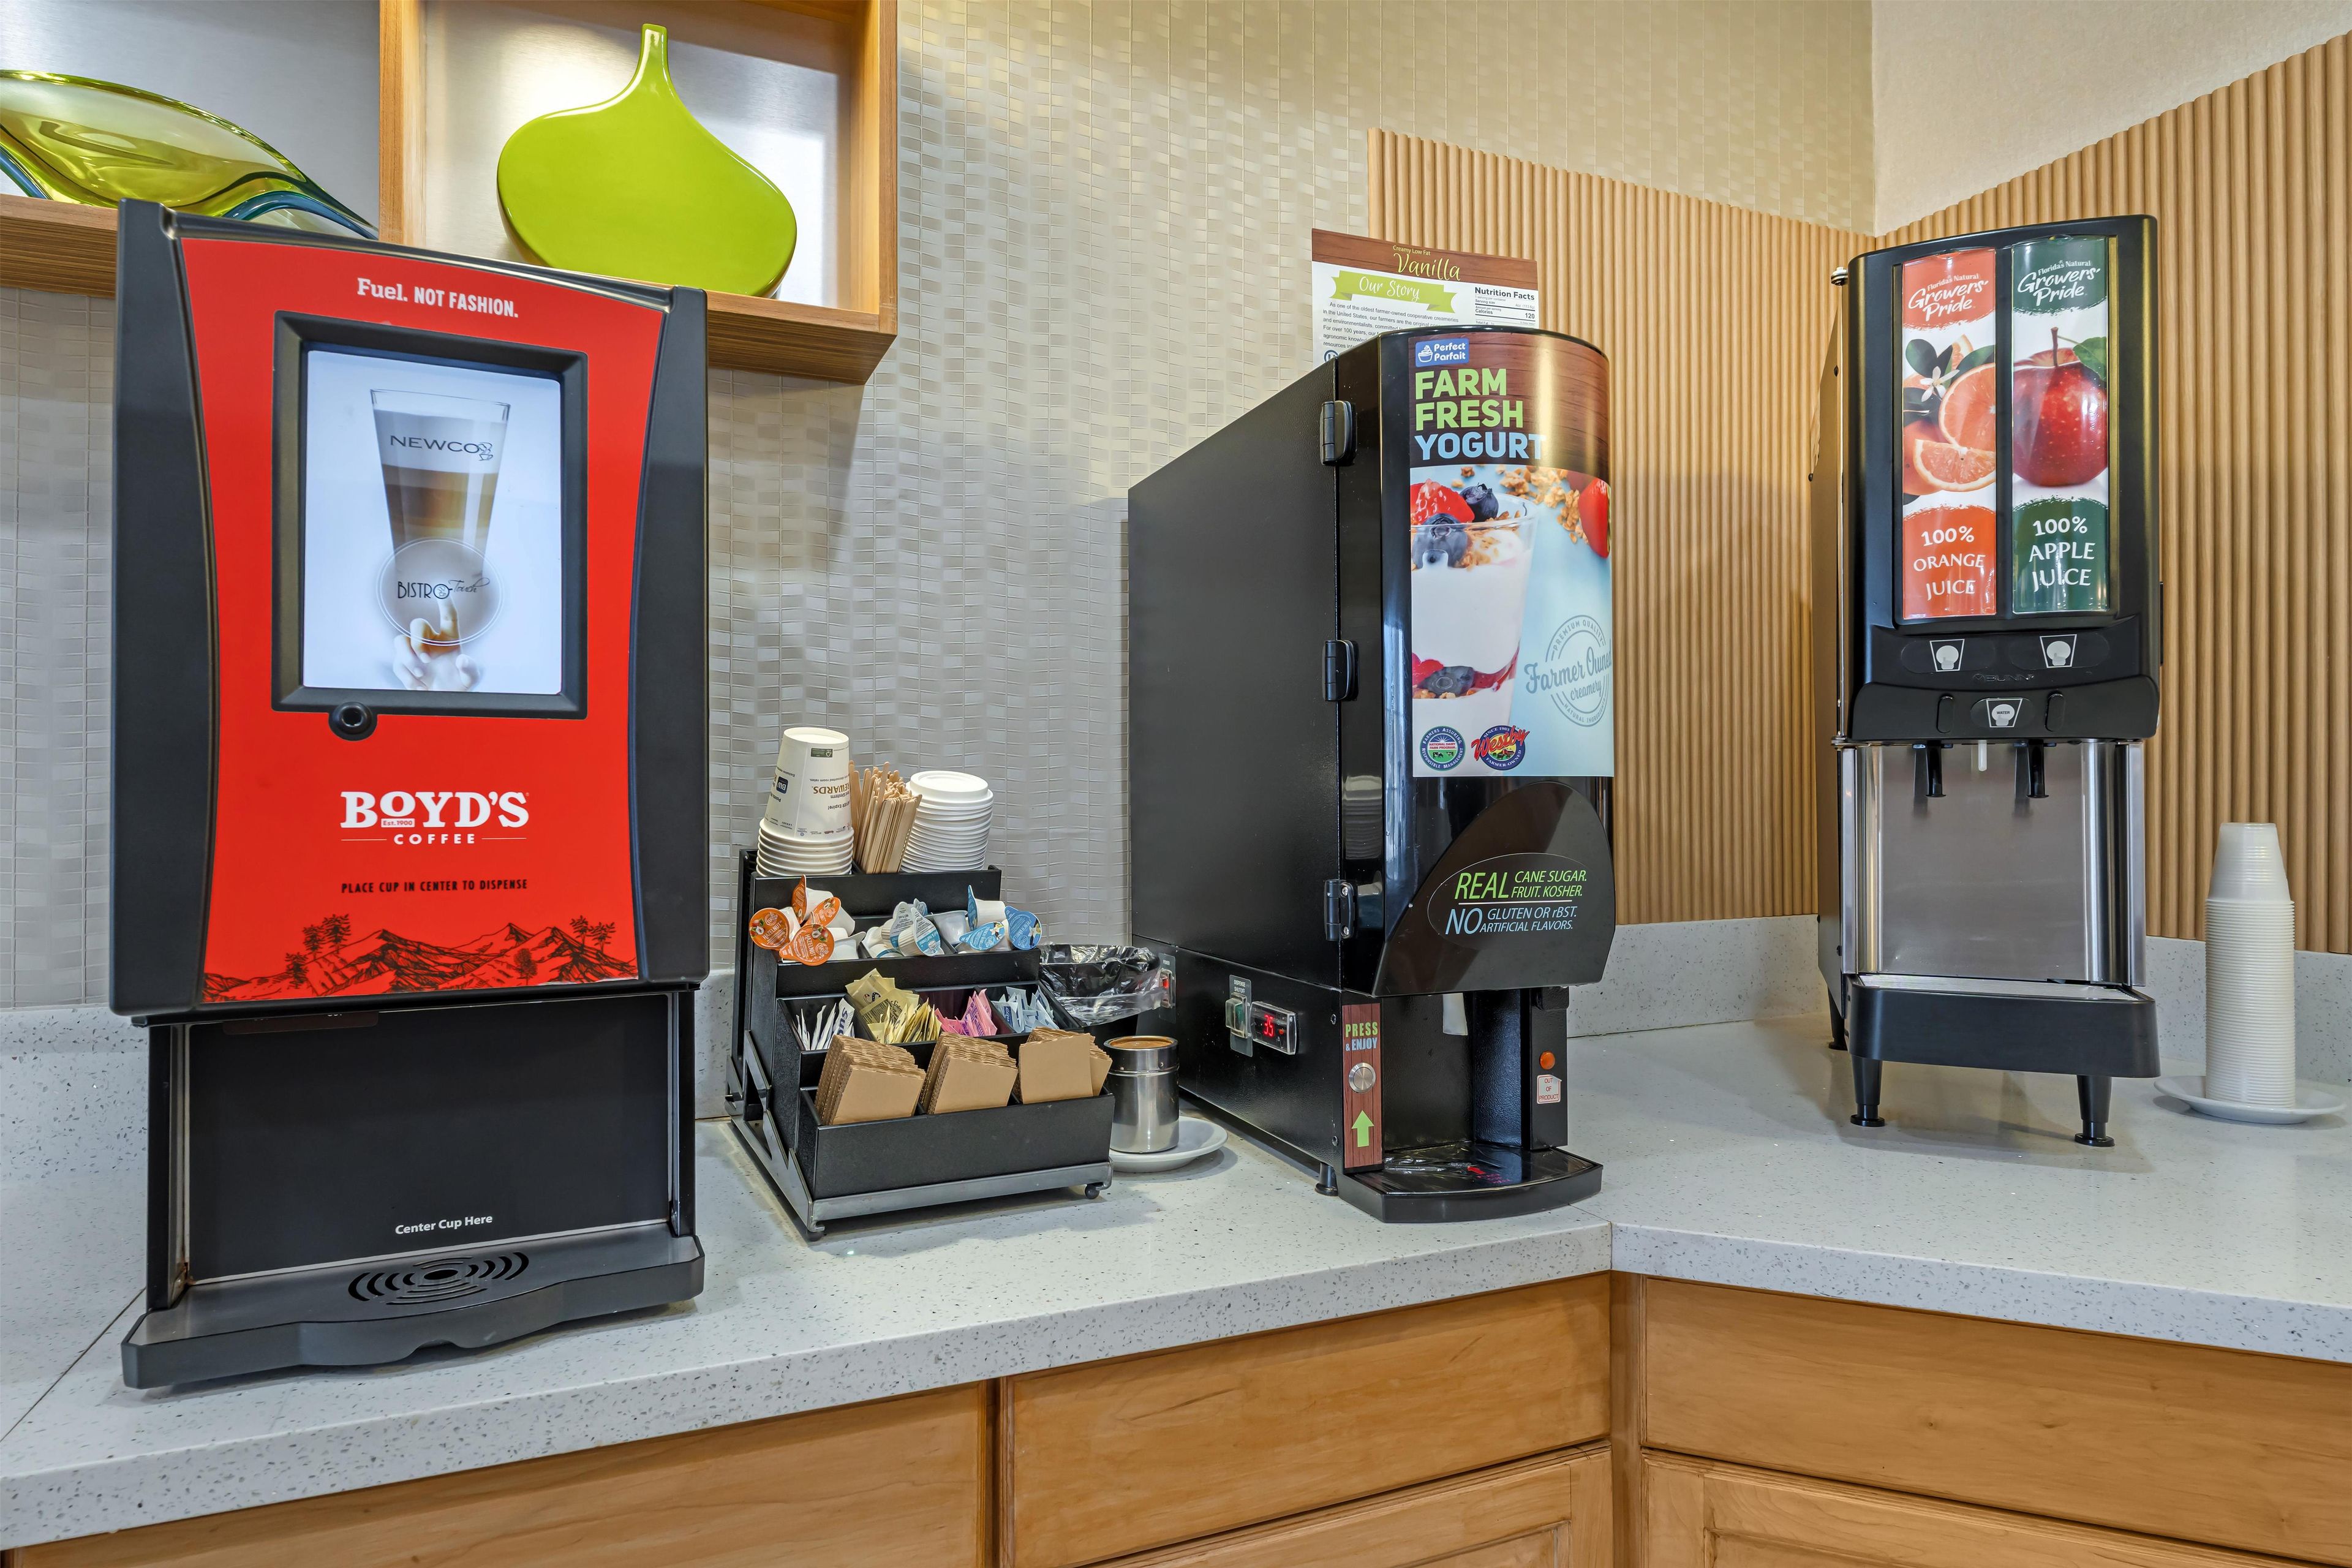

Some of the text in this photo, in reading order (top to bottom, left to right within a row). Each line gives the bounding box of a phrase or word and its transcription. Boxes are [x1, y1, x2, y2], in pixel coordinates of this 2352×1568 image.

[1393, 245, 1411, 254] Creamy
[1393, 252, 1461, 281] Vanilla
[1359, 276, 1420, 302] Our Story
[2018, 268, 2101, 293] Growers'
[357, 277, 518, 318] Fuel. NOT FASHION.
[1475, 287, 1535, 300] Nutrition Facts
[1909, 280, 1989, 309] Growers'
[2033, 282, 2084, 306] Pride
[1922, 295, 1972, 322] Pride
[1333, 320, 1374, 328] environmentalists,
[1434, 342, 1466, 352] Perfect
[1434, 352, 1466, 361] Parfait
[1415, 368, 1507, 399] FARM
[1415, 399, 1523, 431] FRESH
[390, 434, 480, 455] NEWCO
[1414, 432, 1546, 461] YOGURT
[1921, 526, 1975, 547] 100%
[2032, 516, 2087, 536] 100%
[1913, 553, 1986, 571] ORANGE
[2029, 541, 2095, 562] APPLE
[398, 581, 450, 600] BISTRO
[1926, 579, 1976, 600] JUICE
[2032, 568, 2092, 592] JUICE
[1553, 619, 1603, 651] PREMIUM QUALITY
[1524, 638, 1612, 694] Farmer Owned
[1570, 680, 1602, 701] creamery
[1563, 704, 1585, 723] NATURAL
[1422, 728, 1463, 745] FARMERS ASSURING
[1483, 727, 1498, 737] SINCE
[1471, 725, 1530, 761] Westby
[1422, 748, 1464, 769] RESPONSIBLE MANAGEMENT
[777, 782, 786, 791] BW
[340, 791, 529, 828] BOYD'S
[394, 834, 475, 845] COFFEE
[341, 879, 527, 894] PLACE CUP IN CENTER TO DISPENSE
[1454, 870, 1587, 899] REAL CANE SUGAR.
[1511, 885, 1583, 899] FRUIT. KOSHER.
[762, 922, 780, 940] HAZELNUT
[1445, 906, 1578, 935] NO GLUTEN OR rBST.
[1479, 920, 1574, 933] ARTIFICIAL FLAVORS.
[805, 934, 816, 956] HAZELNUT
[1234, 979, 1246, 988] DISPENSE
[1264, 1014, 1273, 1036] 35
[1345, 1022, 1378, 1038] PRESS
[1352, 1037, 1378, 1050] ENJOY
[395, 1215, 493, 1235] Center Cup Here
